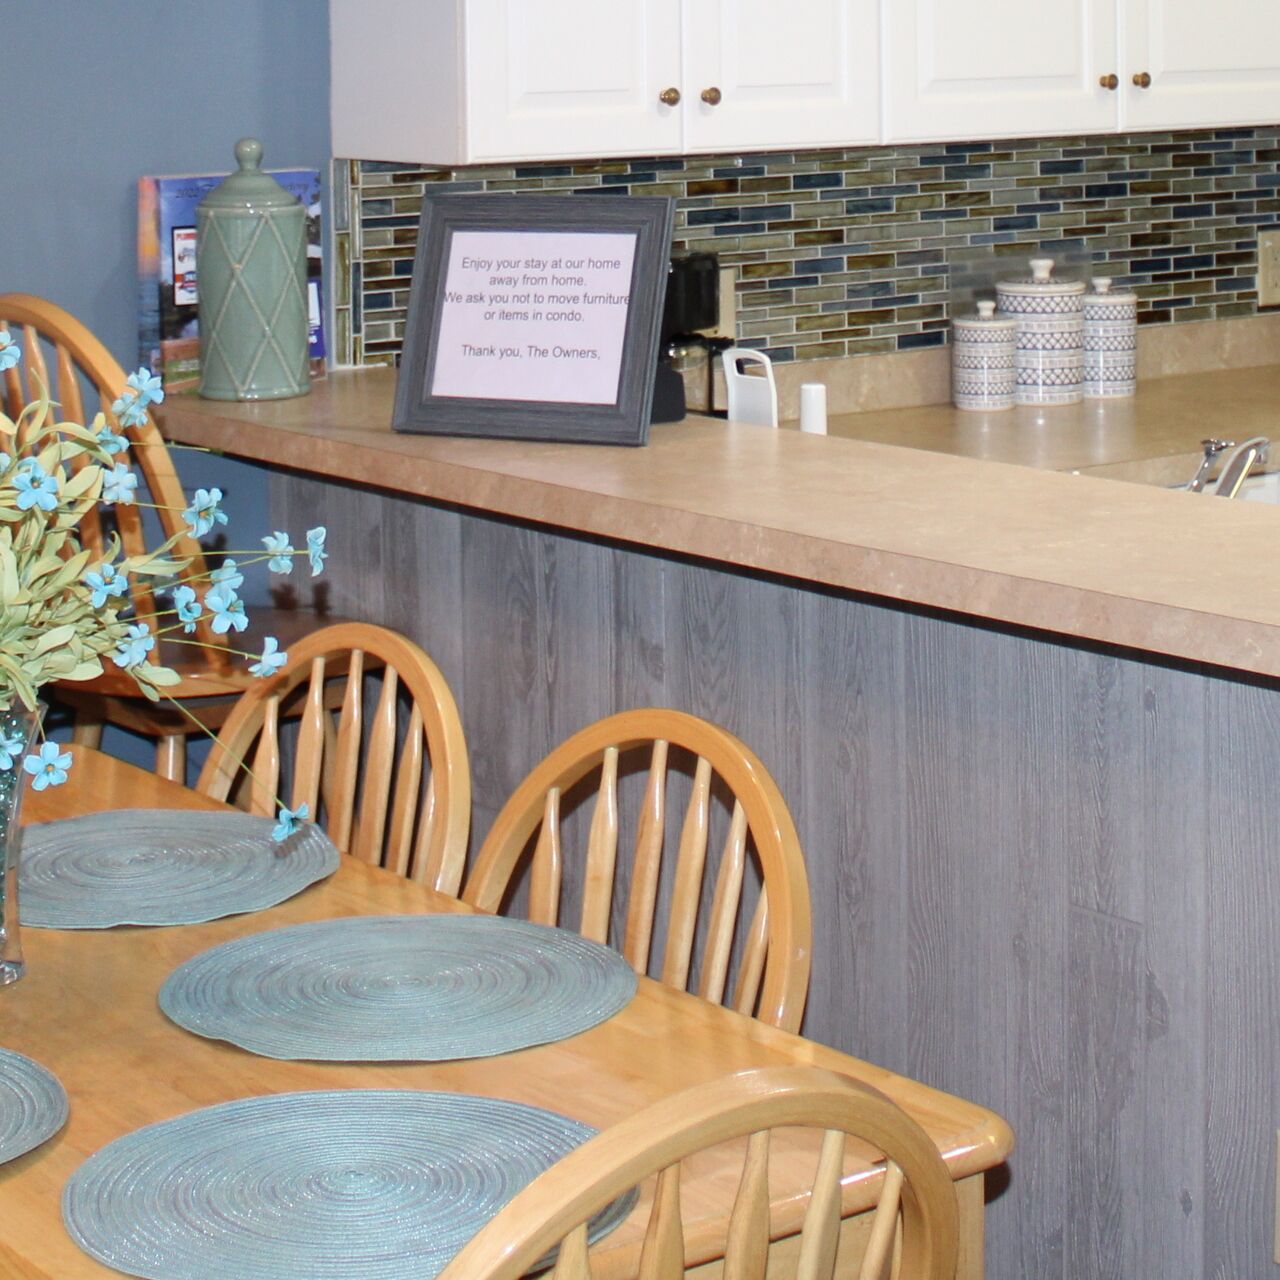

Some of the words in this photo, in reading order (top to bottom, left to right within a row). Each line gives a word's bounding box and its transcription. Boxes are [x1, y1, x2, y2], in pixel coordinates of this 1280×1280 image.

[461, 257, 493, 271] Enjoy
[496, 259, 521, 271] your
[524, 258, 547, 271] stay
[551, 258, 563, 269] at
[566, 259, 586, 269] our
[588, 258, 621, 269] home
[489, 275, 520, 288] away
[522, 274, 548, 286] from
[551, 275, 587, 287] home.
[444, 292, 463, 304] We
[465, 292, 485, 304] ask
[488, 294, 509, 306] you
[512, 293, 531, 304] not
[533, 293, 545, 304] to
[548, 294, 580, 305] move
[583, 292, 631, 306] furniture
[484, 311, 496, 320] or
[499, 309, 529, 321] items
[532, 309, 543, 321] in
[462, 344, 496, 358] Thank
[527, 345, 550, 358] The
